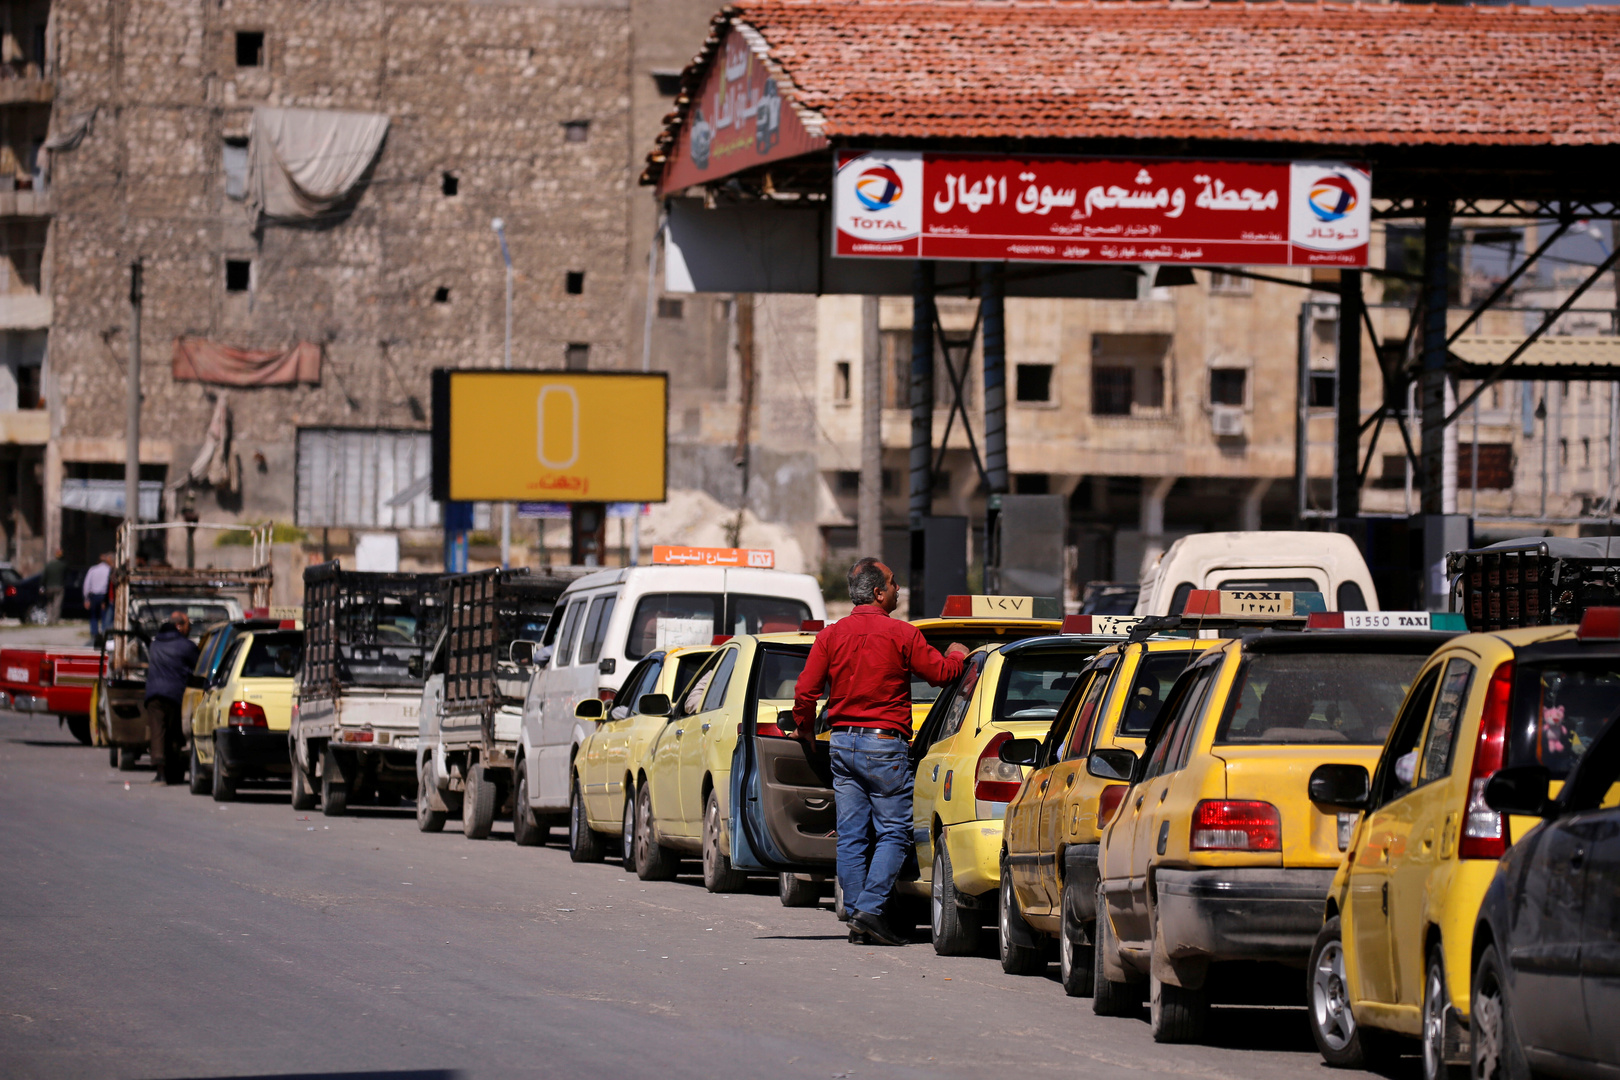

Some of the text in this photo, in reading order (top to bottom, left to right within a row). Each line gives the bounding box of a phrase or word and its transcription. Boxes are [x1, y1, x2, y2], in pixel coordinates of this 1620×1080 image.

[933, 168, 1279, 219] محطة ومشحم سوق الهال
[850, 216, 907, 231] TOTAL
[1307, 228, 1359, 240] توتال
[665, 550, 705, 563] النيل
[706, 550, 738, 564] شارع
[1231, 592, 1281, 600] TAXI
[1398, 617, 1428, 626] TAXI
